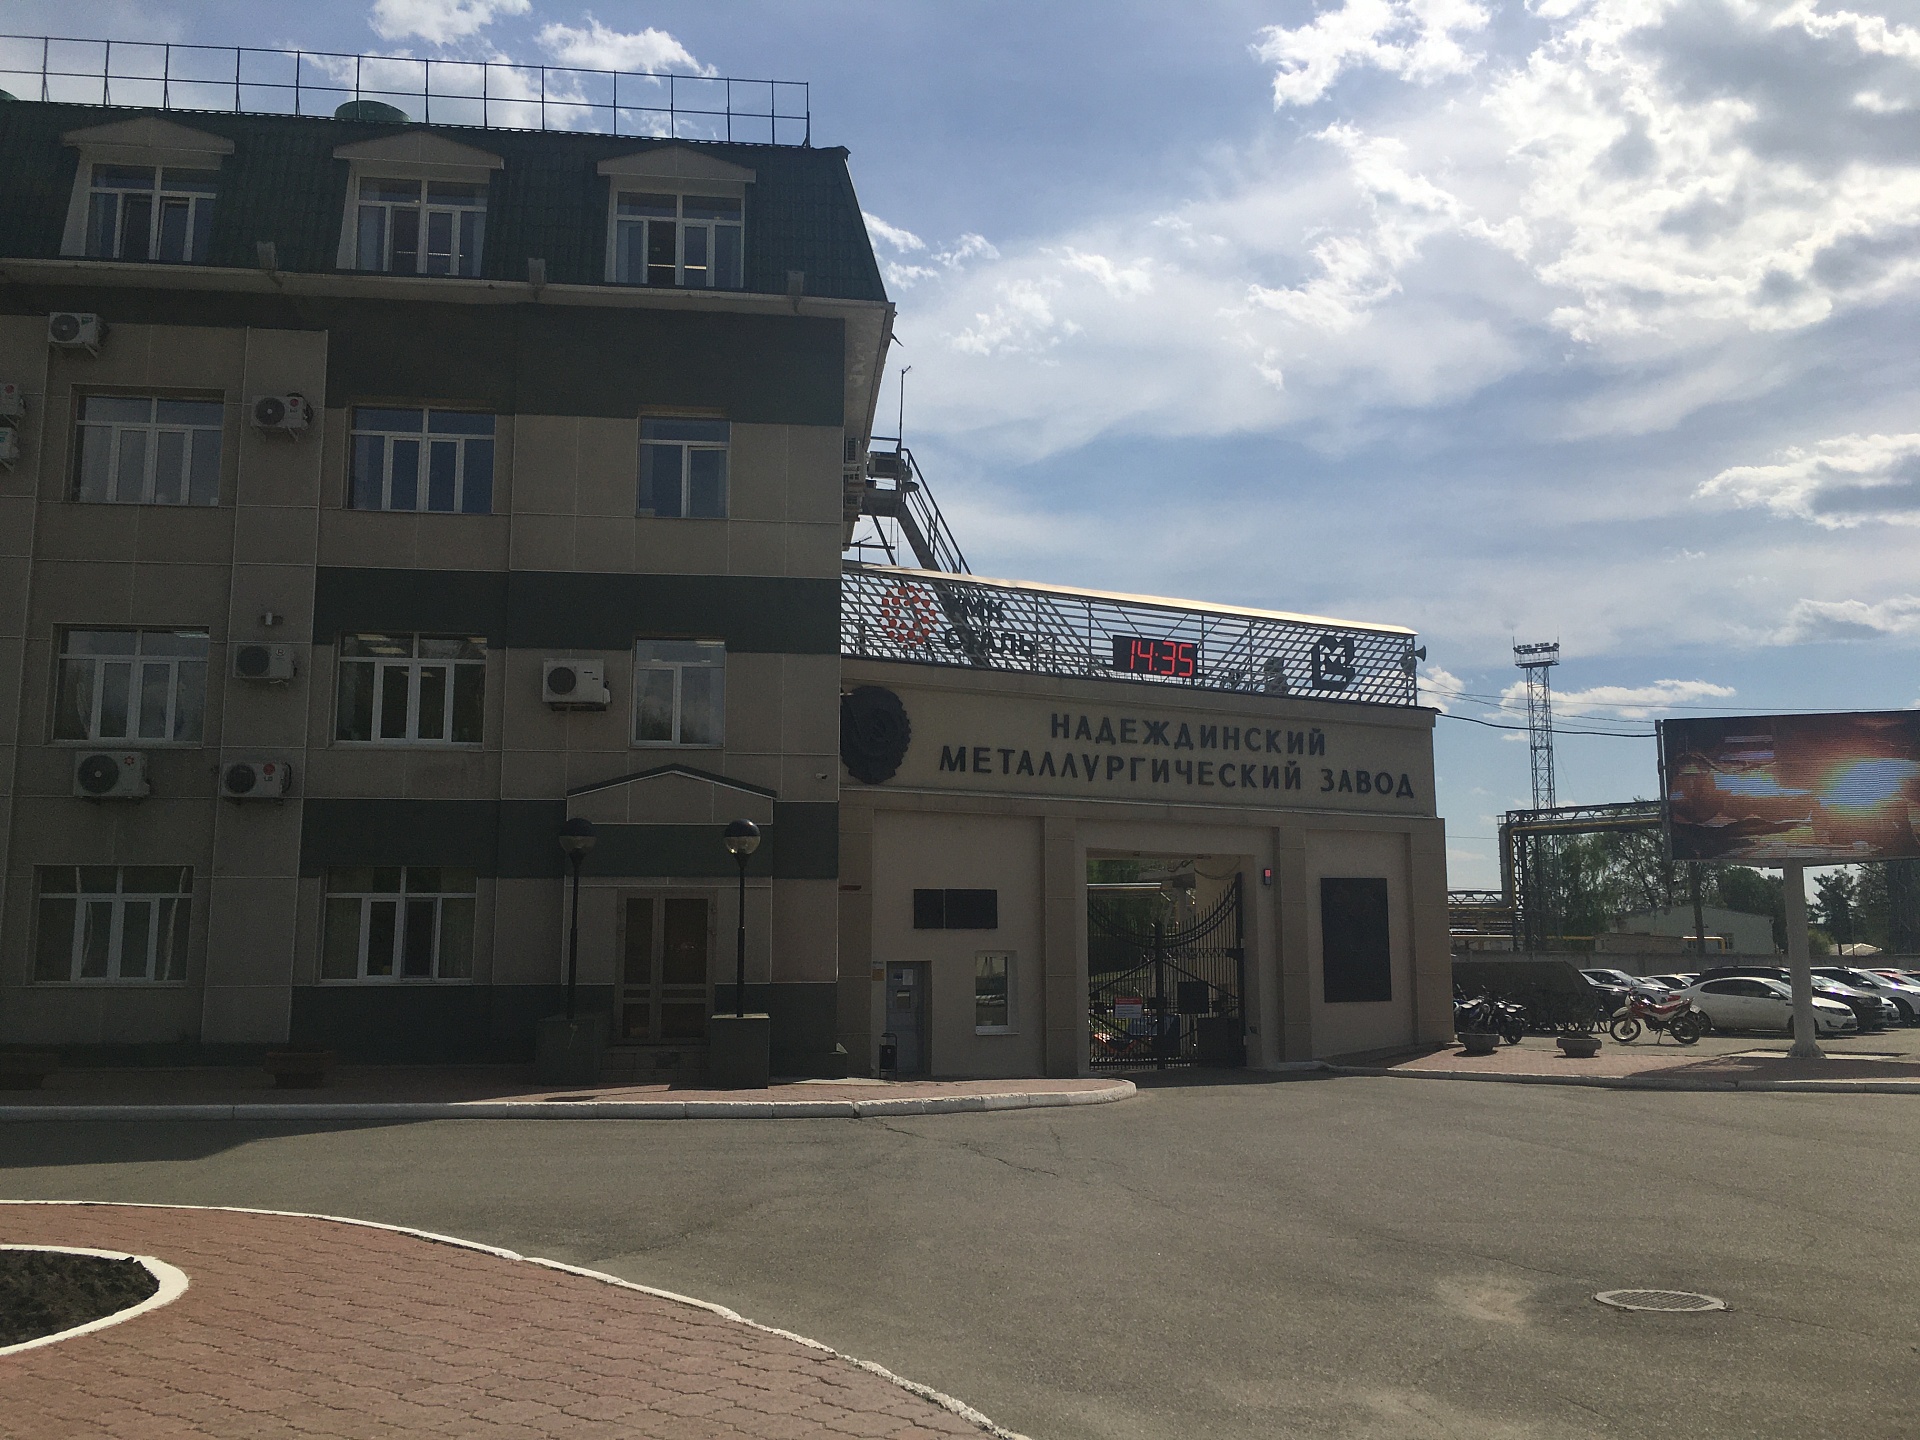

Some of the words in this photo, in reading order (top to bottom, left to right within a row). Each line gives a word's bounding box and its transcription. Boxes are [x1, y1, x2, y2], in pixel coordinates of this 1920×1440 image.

[1130, 640, 1193, 676] 14:35
[1051, 713, 1325, 756] НАДЕЖДИНСКИЙ
[939, 745, 1300, 790] МЕТАЛЛУРГИЧЕСКИЙ
[1320, 768, 1414, 798] ЗАВОД
